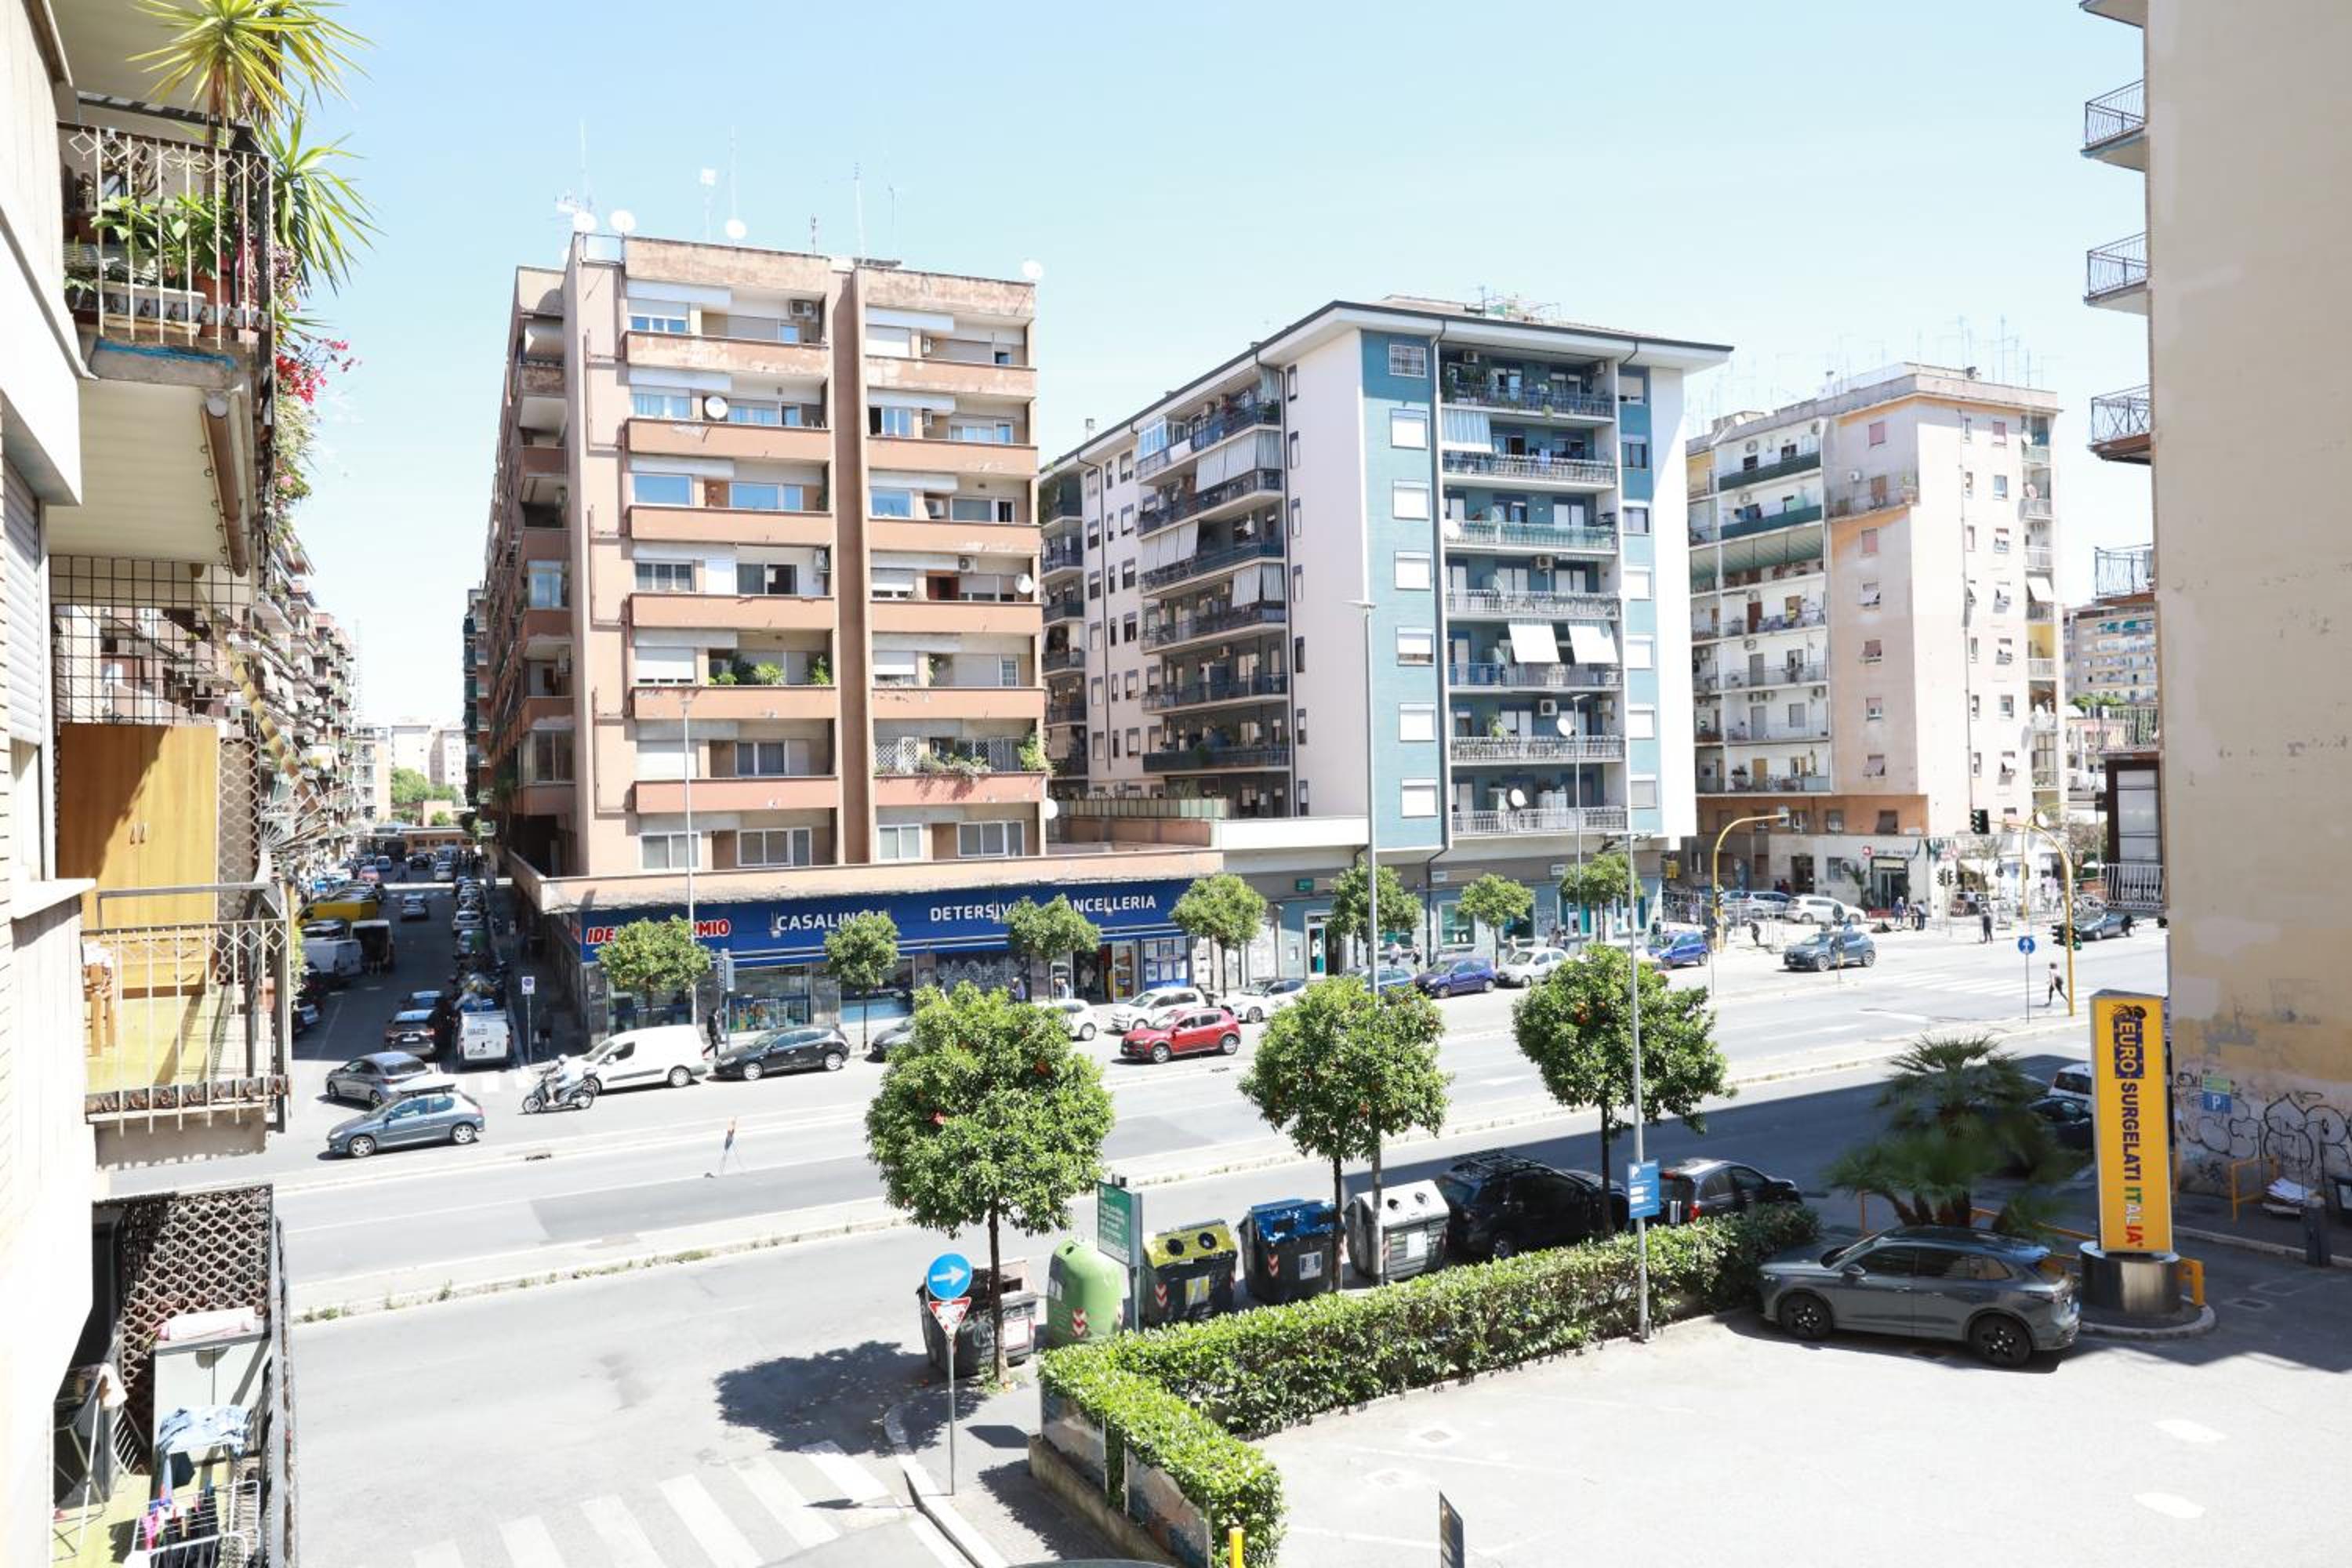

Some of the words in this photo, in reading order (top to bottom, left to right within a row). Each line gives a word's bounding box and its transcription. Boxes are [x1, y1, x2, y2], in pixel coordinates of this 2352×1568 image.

[2118, 1021, 2138, 1073] EURO
[2212, 1094, 2222, 1111] P
[2121, 1083, 2142, 1181] SURGELATI
[2124, 1186, 2144, 1245] ITALIA
